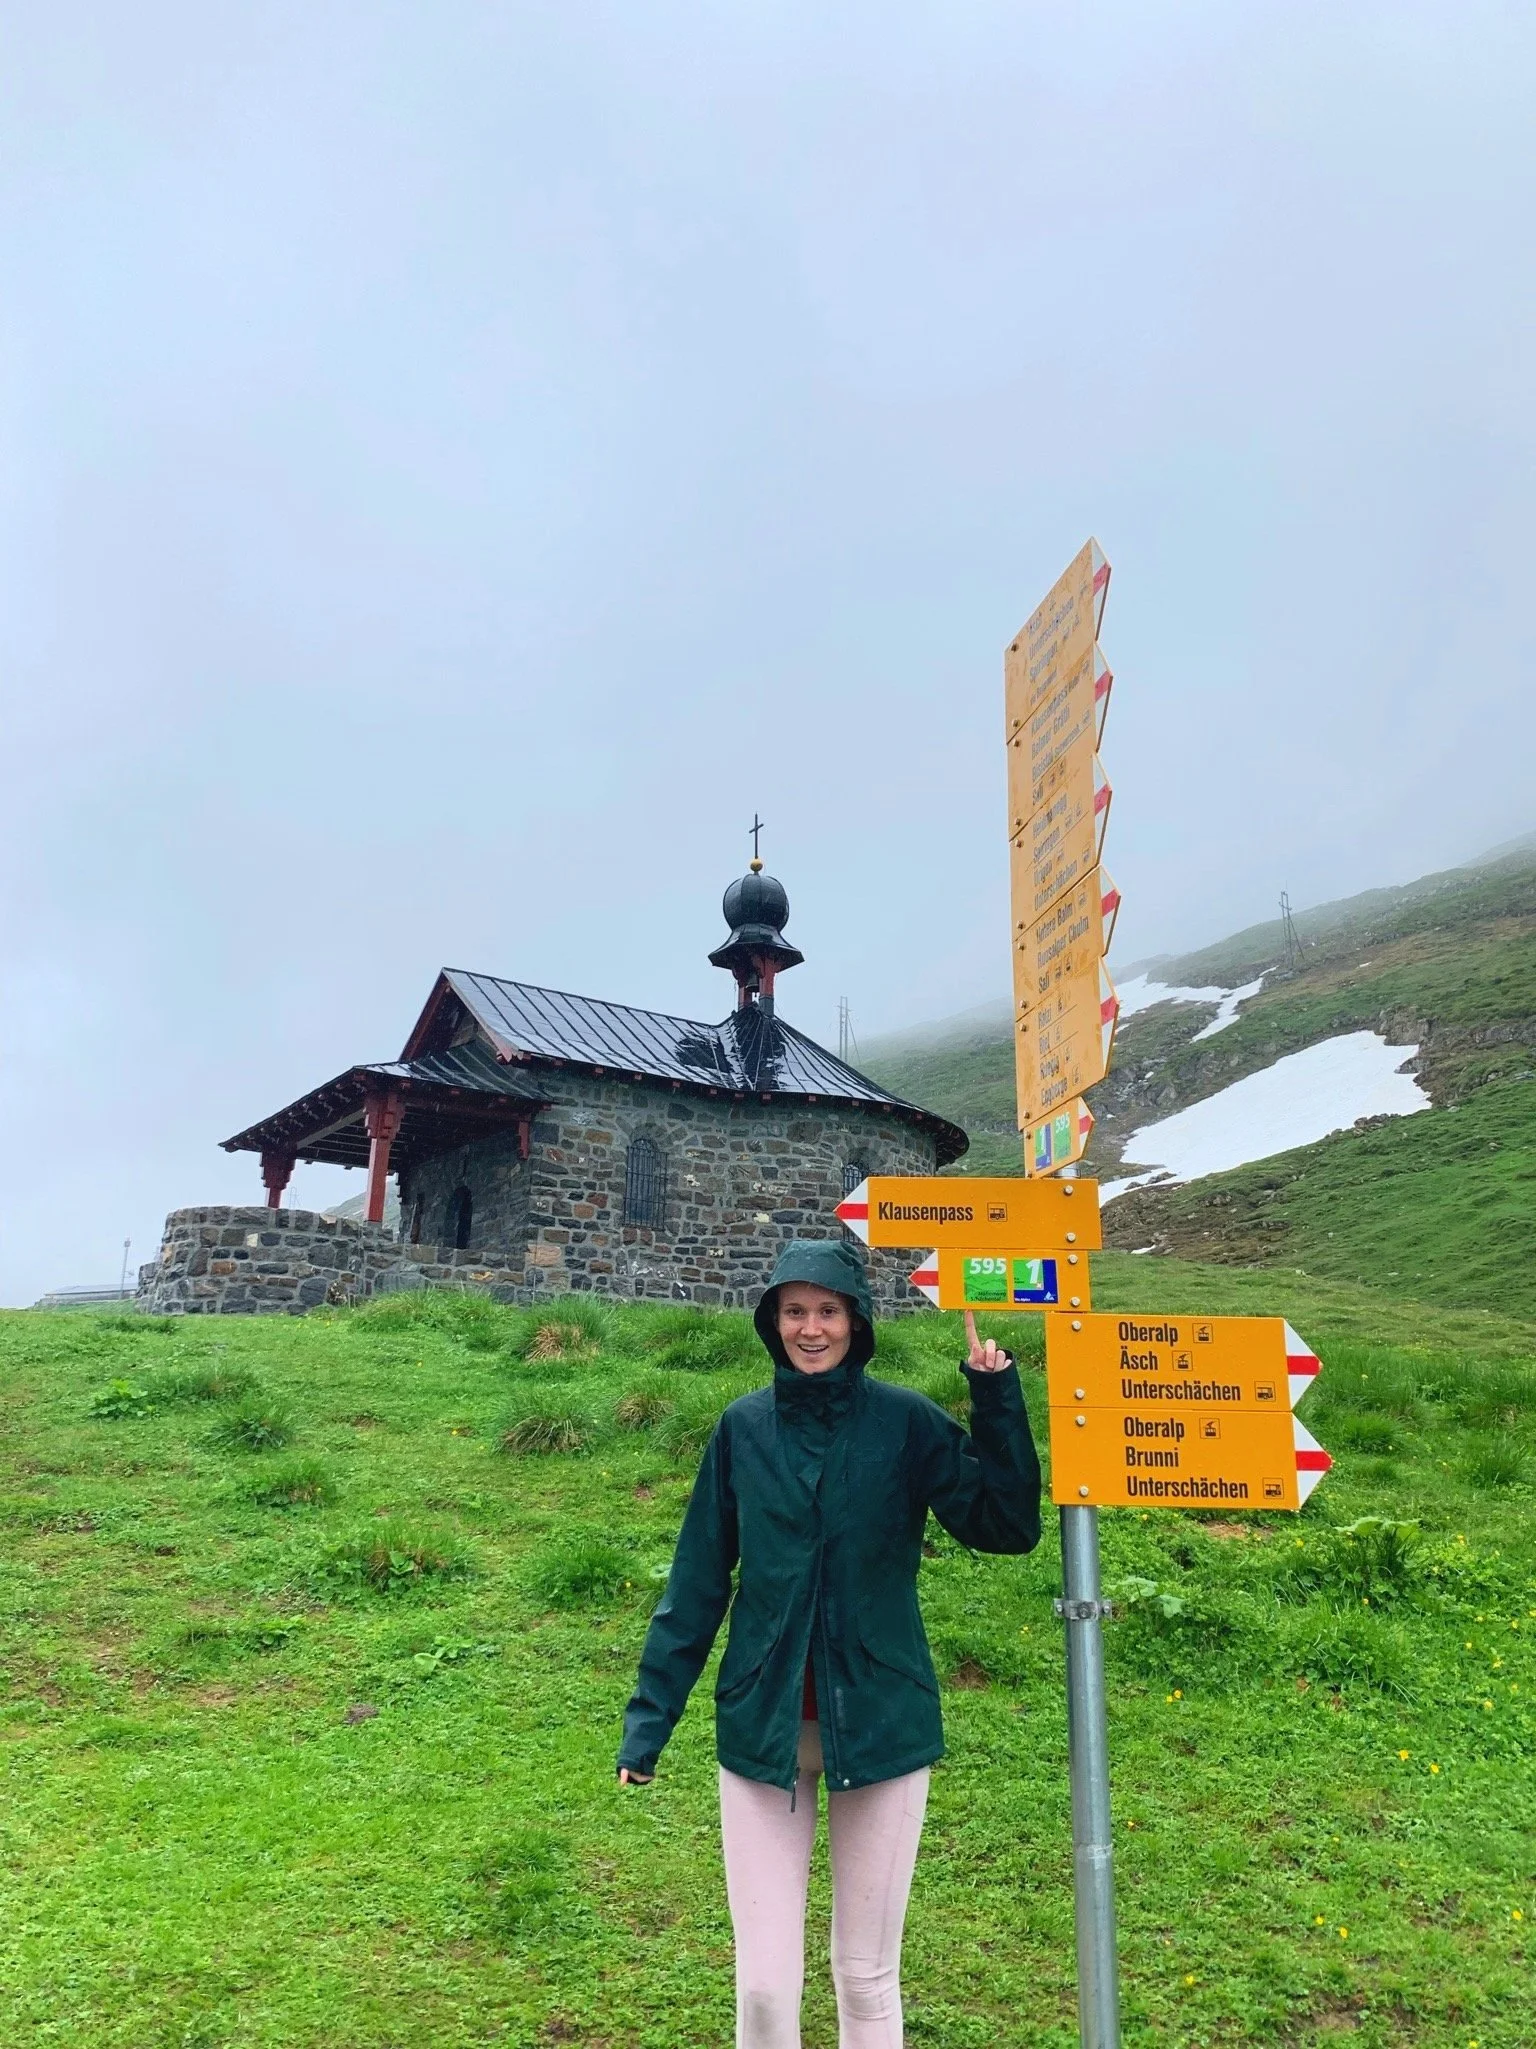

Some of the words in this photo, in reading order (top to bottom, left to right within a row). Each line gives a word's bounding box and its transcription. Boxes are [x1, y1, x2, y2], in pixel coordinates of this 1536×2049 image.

[1057, 902, 1073, 926] Balm
[1055, 1111, 1070, 1133] 595
[878, 1202, 973, 1224] Klausenpass
[969, 1257, 1007, 1275] 595
[1025, 1258, 1040, 1284] 1
[1118, 1321, 1179, 1346] Oberalp
[1120, 1346, 1158, 1370] Äsch
[1121, 1379, 1241, 1401] Unterschächen
[1123, 1416, 1185, 1442] Oberalp
[1125, 1446, 1179, 1467] Brunni
[1127, 1475, 1249, 1499] Unterschächen
